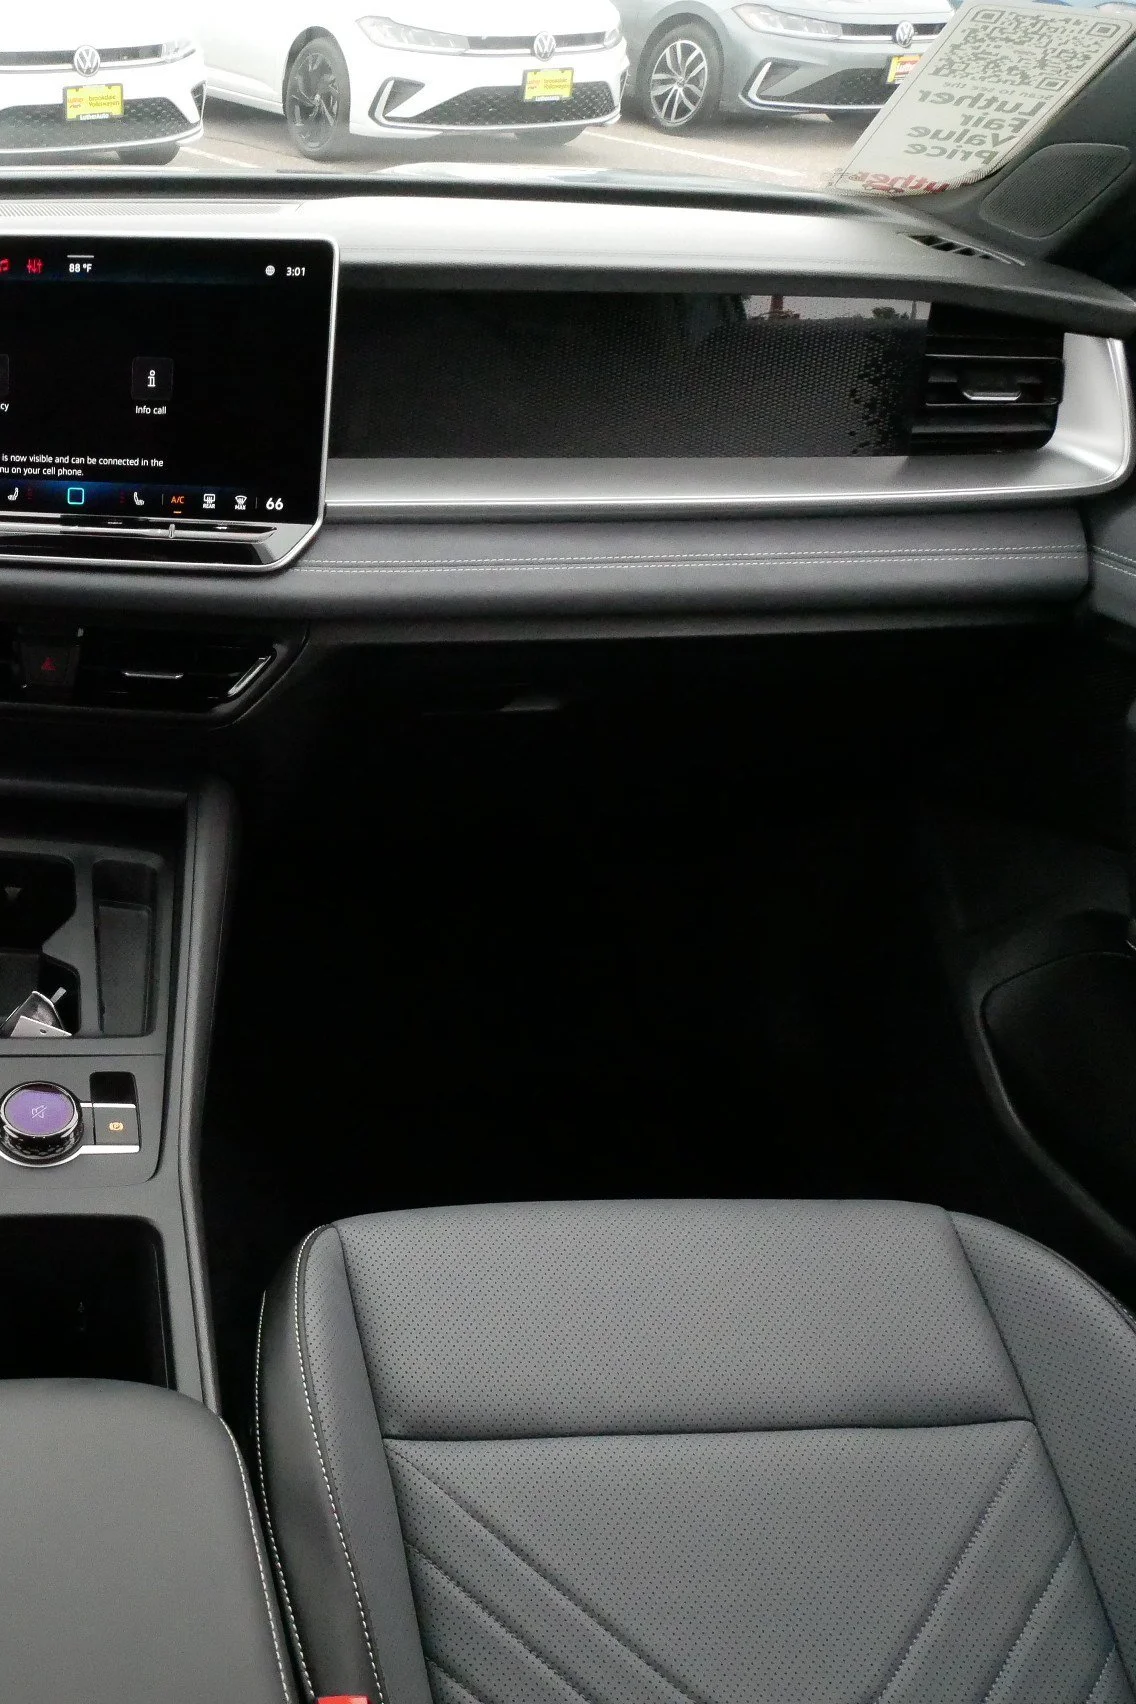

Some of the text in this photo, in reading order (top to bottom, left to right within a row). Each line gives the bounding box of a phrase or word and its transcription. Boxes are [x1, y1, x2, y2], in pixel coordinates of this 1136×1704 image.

[68, 263, 81, 273] 88
[286, 267, 306, 276] 3:01
[135, 405, 167, 415] Info call
[1, 453, 9, 462] is
[10, 455, 28, 463] now
[29, 453, 53, 464] visible
[54, 454, 70, 464] and
[71, 457, 85, 465] can
[86, 455, 97, 465] be
[98, 456, 139, 466] connected
[141, 457, 149, 467] in
[150, 457, 164, 467] the
[23, 467, 41, 477] your
[42, 465, 56, 475] cell
[57, 466, 84, 478] phone.
[170, 495, 185, 504] A/C
[265, 497, 284, 511] 66
